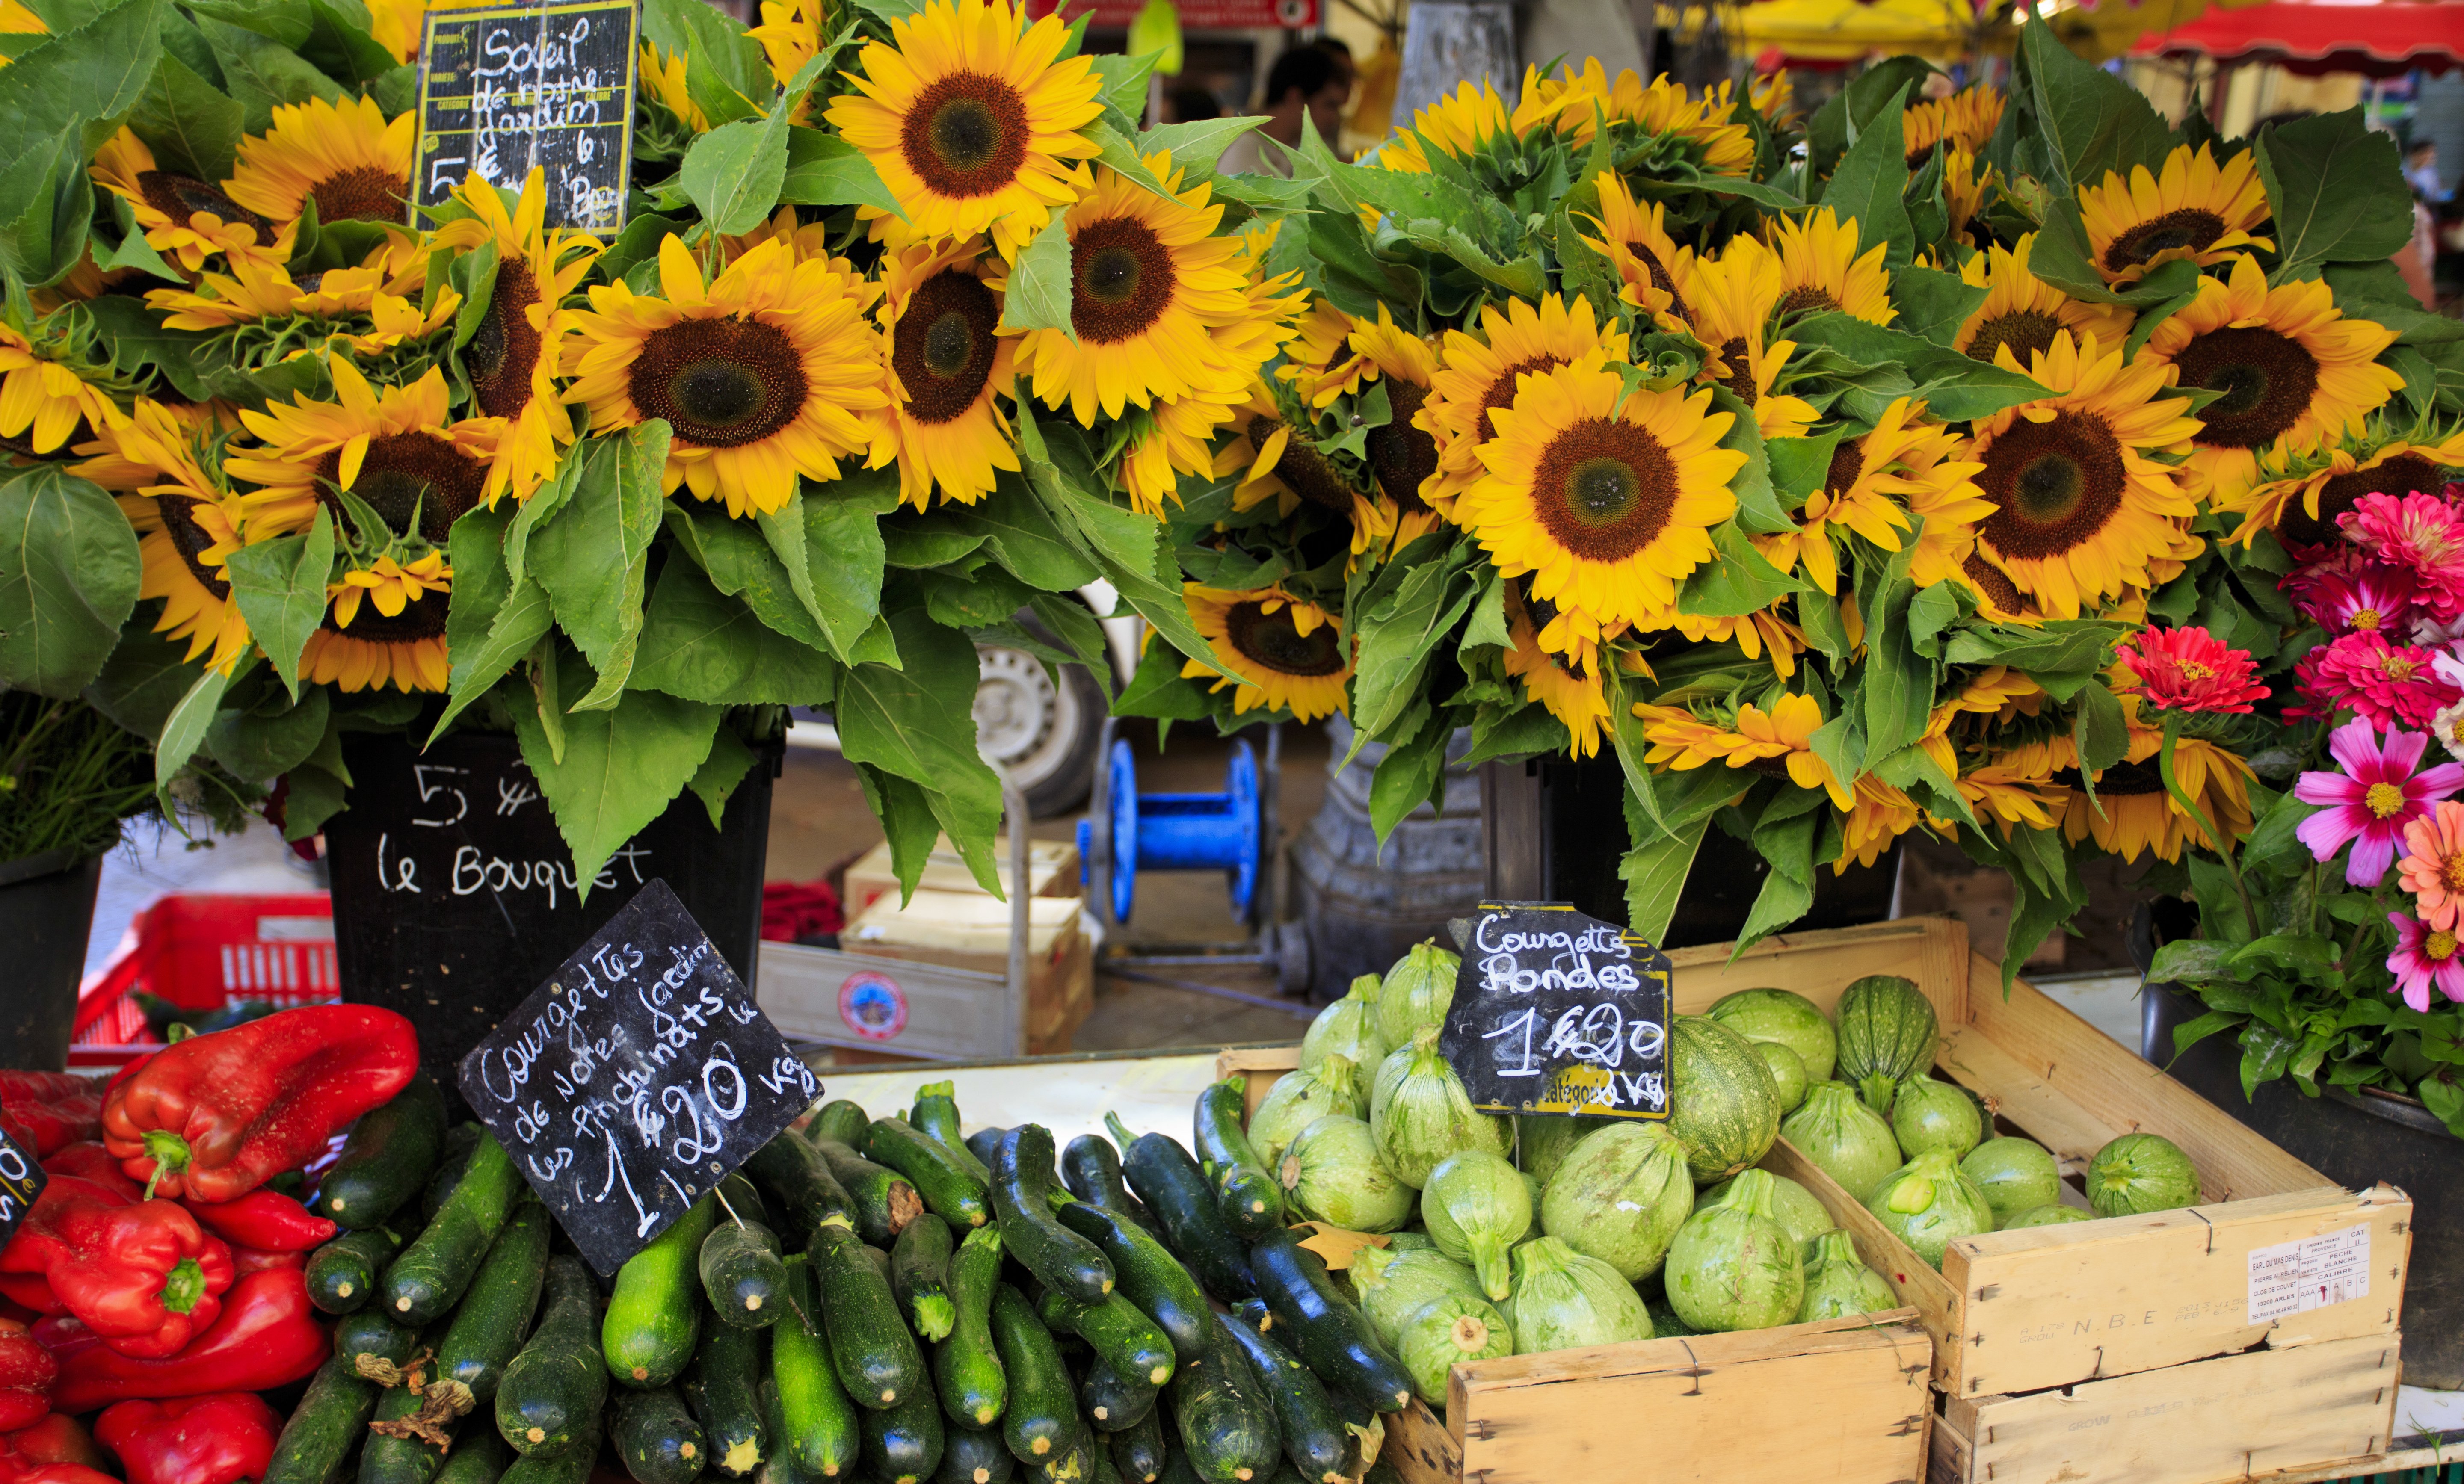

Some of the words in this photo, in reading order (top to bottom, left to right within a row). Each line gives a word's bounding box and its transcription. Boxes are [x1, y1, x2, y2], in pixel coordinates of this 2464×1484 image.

[471, 17, 589, 77] Soleil
[472, 79, 507, 112] de
[585, 91, 611, 101] CALIBRE
[412, 764, 469, 827] 5
[1478, 952, 1640, 994] Rondes
[515, 1100, 550, 1144] de
[2351, 1229, 2365, 1237] CAT
[2311, 1244, 2337, 1253] PROVENCE
[2330, 1249, 2353, 1259] PECHE
[2253, 1262, 2265, 1271] EARL
[2274, 1256, 2284, 1265] MAS
[2285, 1253, 2298, 1263] DENIS
[2324, 1256, 2357, 1268] BLANCHE
[2254, 1275, 2272, 1284] PIERRE
[2273, 1268, 2298, 1279] AURELIEN
[2318, 1267, 2353, 1280] CALIBRE
[2254, 1289, 2267, 1297] CLOS
[2276, 1281, 2296, 1291] COUVET
[2300, 1289, 2315, 1298] AAA
[2257, 1299, 2273, 1307] 13200
[2274, 1294, 2295, 1302] ARLES
[2068, 1415, 2111, 1432] GROW
